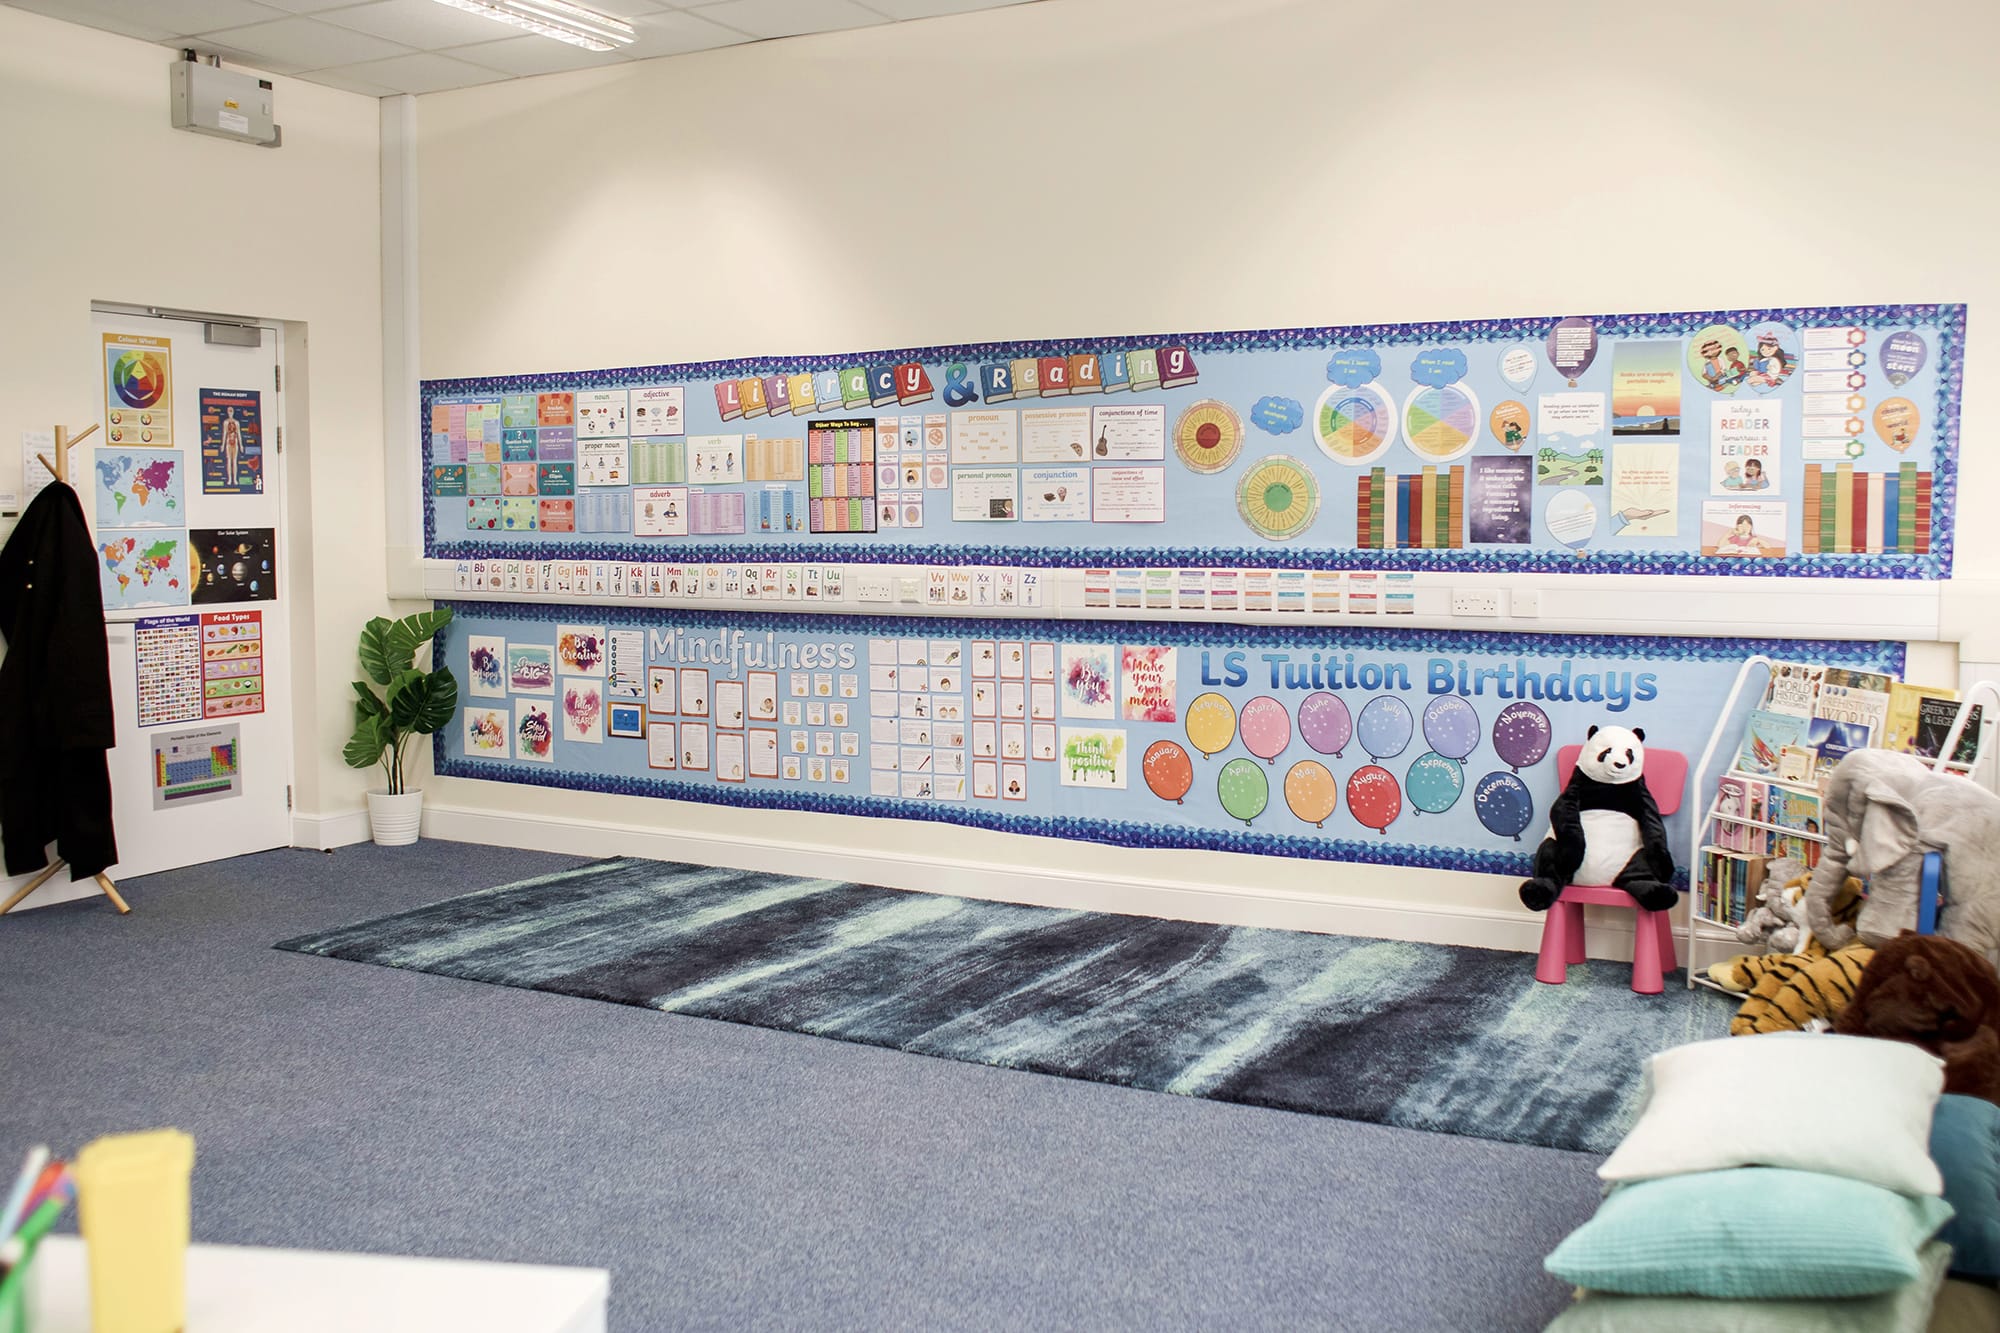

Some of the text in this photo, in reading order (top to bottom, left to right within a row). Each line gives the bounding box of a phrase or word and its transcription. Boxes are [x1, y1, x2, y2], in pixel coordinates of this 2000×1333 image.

[118, 335, 158, 345] Colour Wheel
[643, 390, 669, 399] adjective
[968, 415, 999, 423] pronoun
[1025, 411, 1087, 420] possessive pronoun
[1099, 409, 1135, 418] conjunctions
[1136, 409, 1143, 417] of
[1720, 418, 1770, 430] READER
[1721, 444, 1769, 456] LEADER
[957, 472, 1012, 480] personal pronoun
[1033, 470, 1078, 480] conjunction
[649, 490, 671, 498] adverb
[457, 563, 469, 572] Aa
[474, 563, 485, 573] Bb
[490, 563, 501, 573] Cc
[507, 563, 519, 573] Dd
[525, 565, 536, 574] Ee
[542, 564, 552, 576] Ff
[557, 566, 571, 578] Gg
[575, 566, 588, 577] Hh
[596, 566, 603, 576] Ii
[630, 567, 643, 577] Kk
[651, 567, 660, 577] Ll
[666, 567, 682, 576] Mm
[687, 567, 699, 576] Nn
[706, 568, 718, 577] Oo
[613, 567, 622, 580] Jj
[726, 568, 738, 579] Pp
[745, 568, 758, 580] Qq
[765, 569, 777, 578] Rr
[786, 569, 798, 579] Ss
[807, 569, 818, 580] Tt
[826, 570, 841, 580] Uu
[931, 572, 945, 583] Vv
[951, 573, 970, 583] Ww
[976, 574, 990, 583] Xx
[1001, 573, 1013, 585] Yy
[1024, 574, 1037, 584] Zz
[213, 613, 250, 622] Food Types
[574, 636, 587, 648] Be
[562, 647, 602, 661] Creative
[649, 627, 857, 680] Mindfulness
[1132, 657, 1165, 673] Make
[1132, 672, 1163, 687] your
[1201, 651, 1658, 712] LS Tuition Birthdays
[1137, 684, 1162, 694] own
[1777, 679, 1811, 693] WORLD
[1776, 689, 1810, 702] HISTORY
[1129, 694, 1170, 711] magic
[1307, 698, 1330, 714] June
[1823, 695, 1882, 715] PREHISTORIC
[1193, 701, 1233, 719] February
[1247, 702, 1278, 717] March
[1381, 701, 1401, 718] July
[1428, 702, 1465, 721] October
[1920, 703, 1945, 715] GREEK
[1501, 709, 1548, 734] November
[1075, 740, 1106, 755] Think
[1070, 753, 1114, 769] positive
[1146, 746, 1180, 767] January
[1228, 766, 1251, 777] April
[1294, 767, 1316, 780] May
[1420, 759, 1460, 789] September
[1352, 772, 1388, 792] August
[1477, 777, 1522, 803] December
